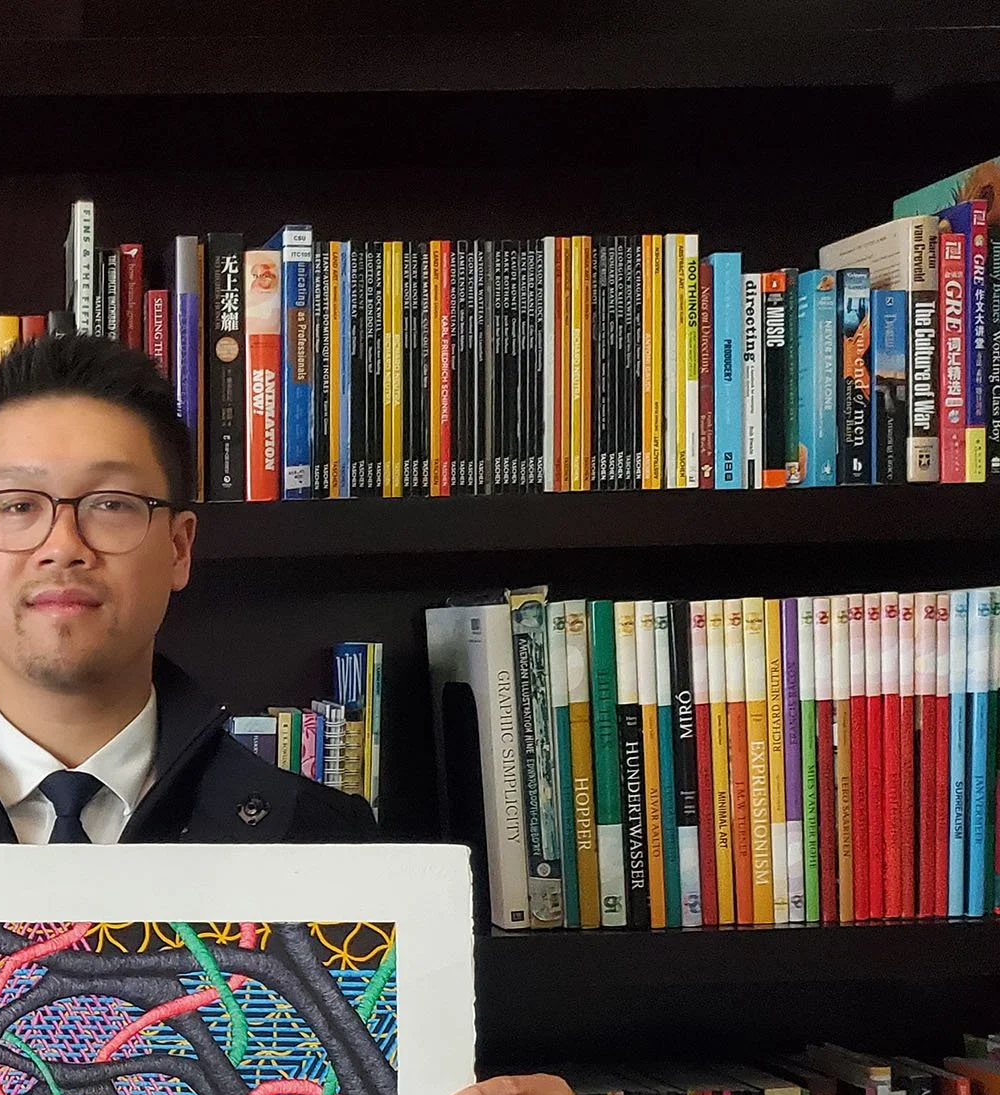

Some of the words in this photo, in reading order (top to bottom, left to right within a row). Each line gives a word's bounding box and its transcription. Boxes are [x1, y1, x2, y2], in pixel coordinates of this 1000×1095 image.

[221, 255, 239, 332] 无上荣耀
[688, 260, 697, 281] 100
[973, 254, 985, 286] GRE
[688, 283, 697, 327] THINGS
[744, 281, 758, 362] directing
[767, 306, 785, 347] MUSIC
[914, 301, 936, 324] The
[945, 281, 963, 333] GRE
[974, 289, 985, 349] 作文大讲堂
[914, 327, 936, 378] Culture
[264, 370, 276, 471] ANIMATION
[914, 401, 936, 430] War
[771, 658, 780, 701] NEUTRA
[497, 670, 513, 743] GRAPHIC
[674, 690, 693, 739] MIRÓ
[771, 704, 781, 752] RICHARD
[502, 748, 520, 844] SIMPLICITY
[575, 778, 592, 851] HOPPER
[626, 742, 644, 890] HUNDERTWASSER
[717, 791, 728, 830] MINIMAL
[751, 741, 769, 886] EXPRESSIONISM
[955, 781, 963, 839] SURREALISM
[719, 833, 728, 849] ART
